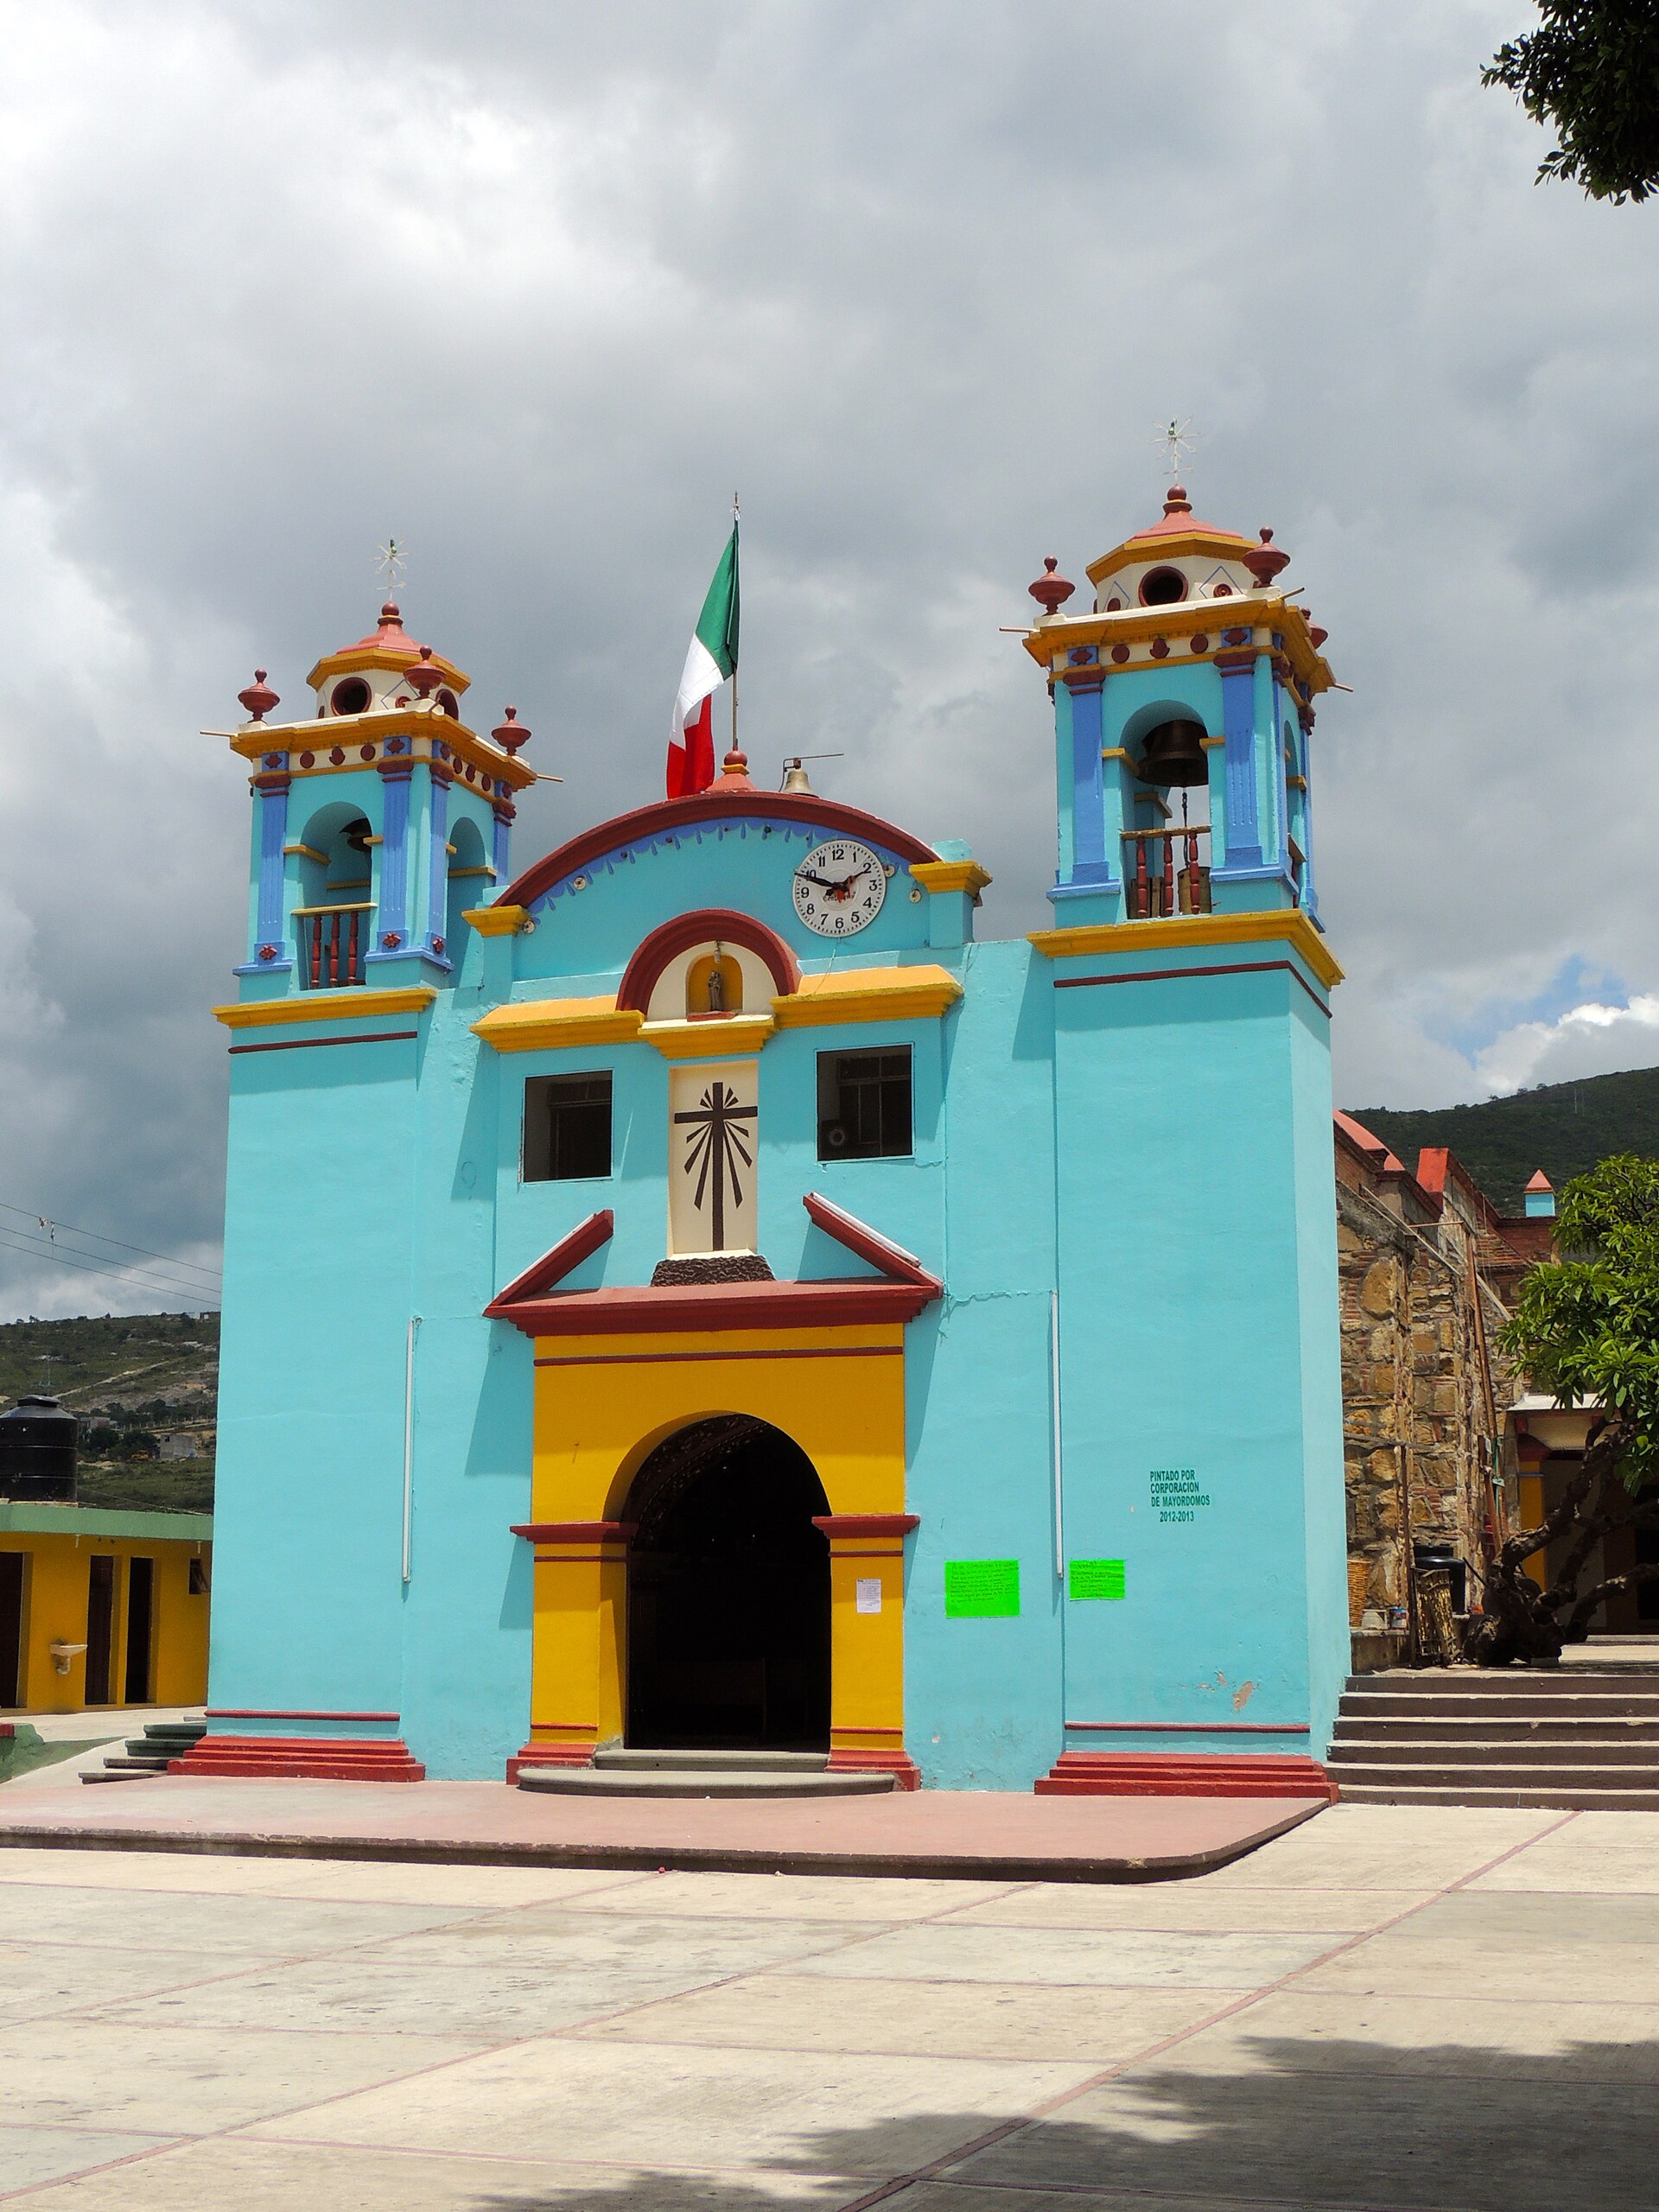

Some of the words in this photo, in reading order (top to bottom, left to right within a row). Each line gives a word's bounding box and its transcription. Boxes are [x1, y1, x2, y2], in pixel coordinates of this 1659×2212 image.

[831, 849, 844, 861] 12
[853, 851, 856, 863] 1
[818, 855, 825, 868] 11
[863, 862, 871, 874] 2
[869, 880, 878, 891] 3
[801, 887, 810, 898] 9
[862, 897, 872, 908] 4
[806, 903, 815, 915] 8
[820, 913, 829, 925] 7
[851, 911, 860, 923] 5
[835, 918, 844, 929] 6
[1150, 1470, 1179, 1482] PINTADO
[1180, 1469, 1195, 1481] POR
[1150, 1481, 1199, 1494] CORPORACION
[1151, 1496, 1160, 1507] DE
[1162, 1495, 1211, 1507] MAYORDOMOS
[1160, 1510, 1194, 1522] 2012-2013
